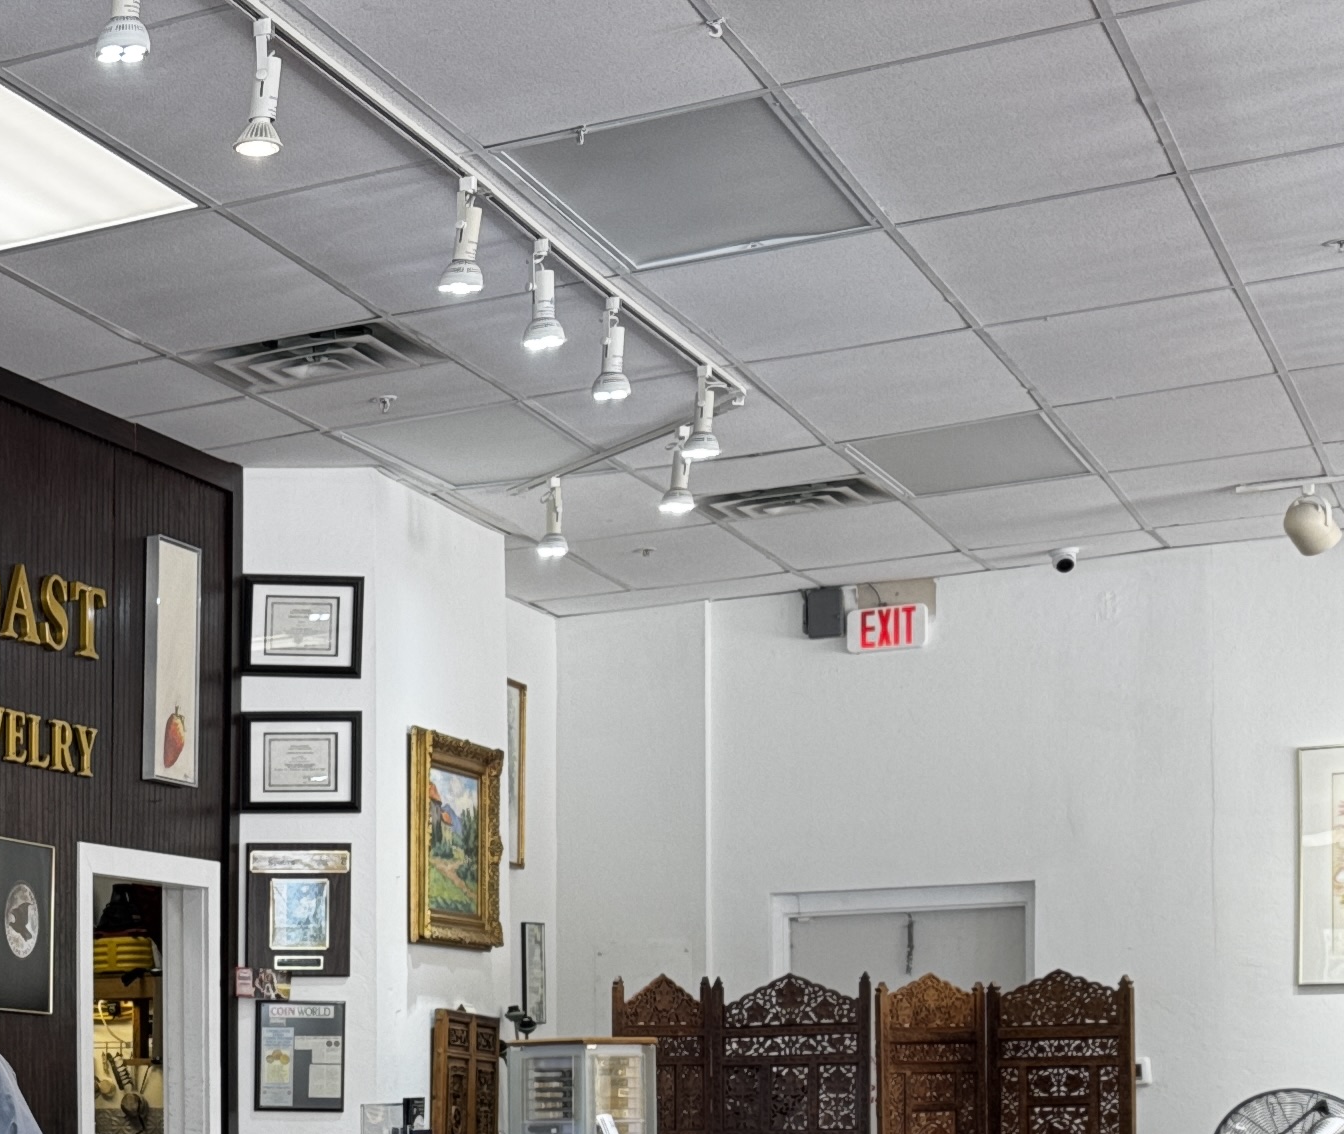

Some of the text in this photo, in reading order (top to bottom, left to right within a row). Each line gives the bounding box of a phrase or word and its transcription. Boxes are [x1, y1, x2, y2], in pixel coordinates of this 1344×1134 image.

[860, 605, 916, 649] EXIT
[270, 1006, 331, 1017] COIN WORLD
